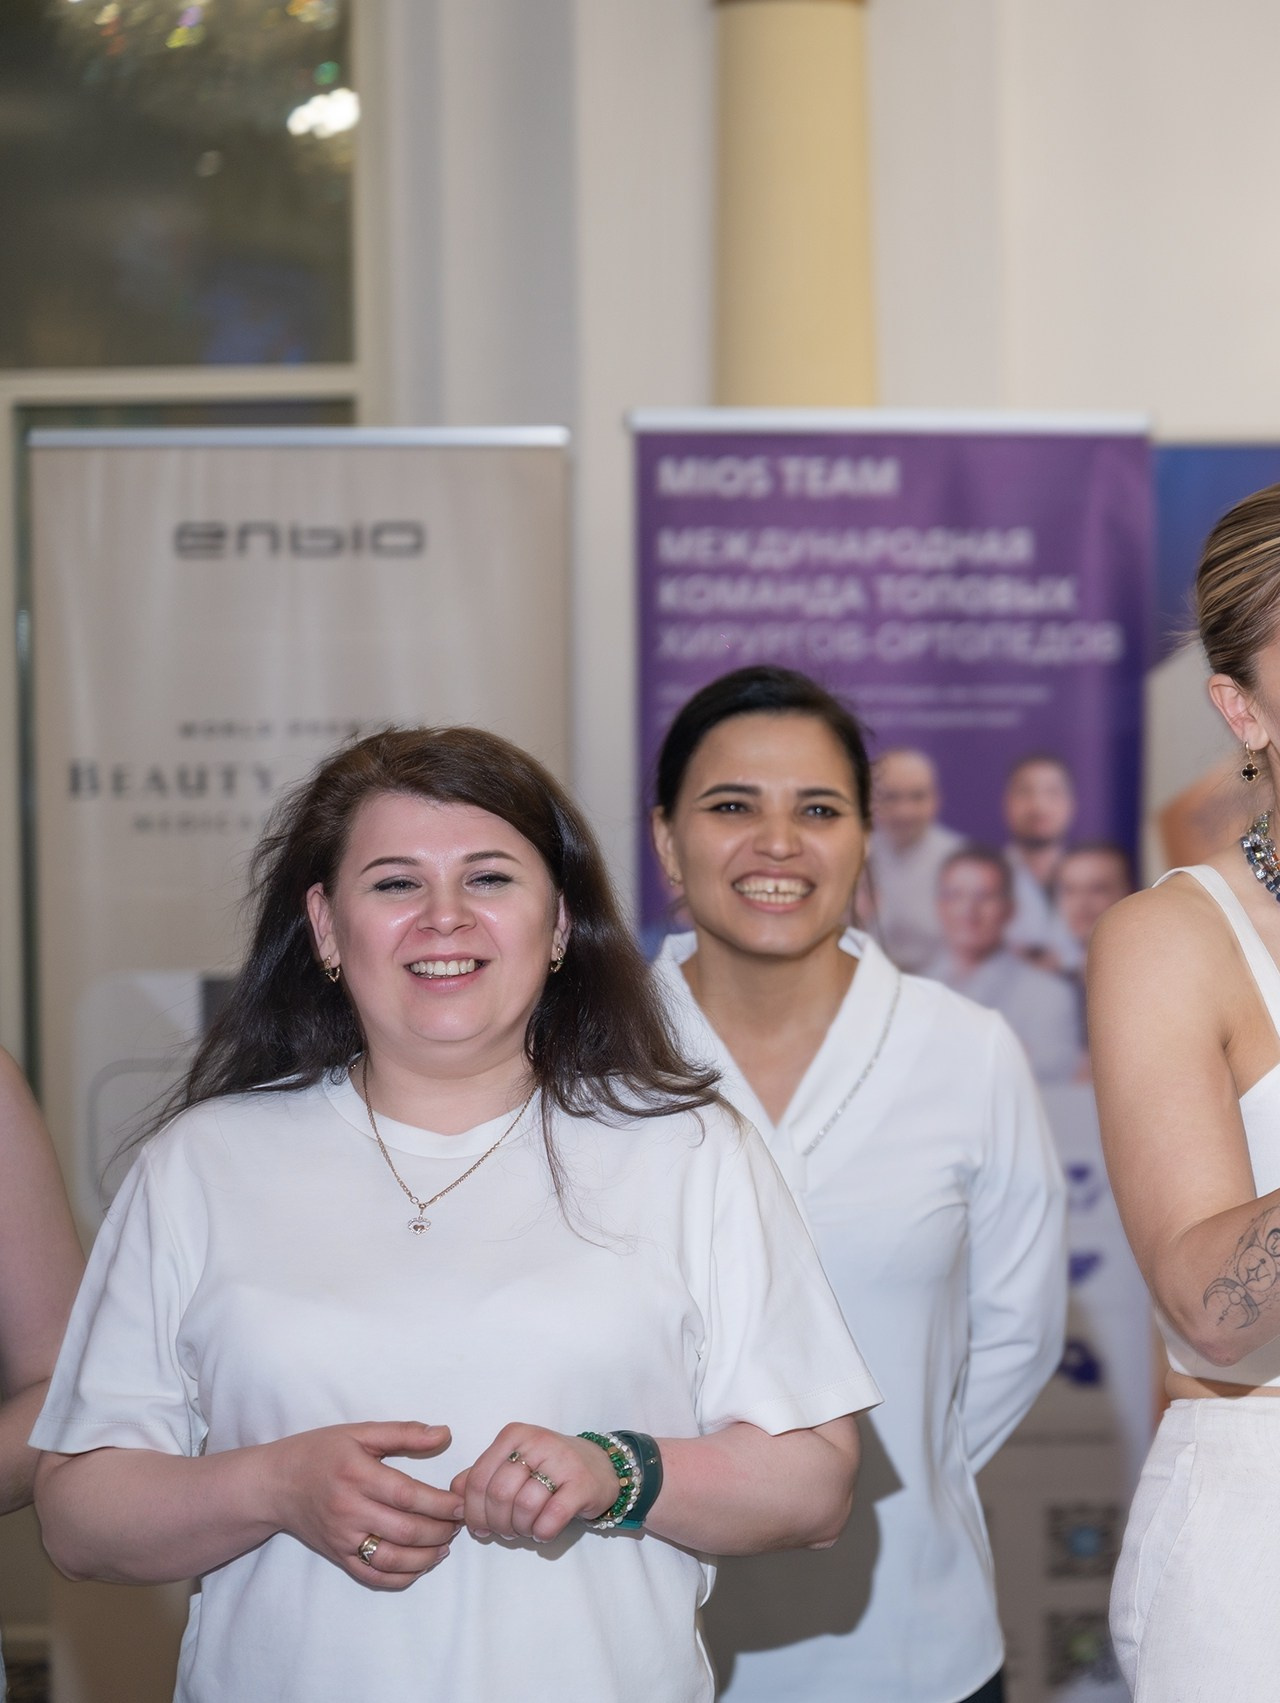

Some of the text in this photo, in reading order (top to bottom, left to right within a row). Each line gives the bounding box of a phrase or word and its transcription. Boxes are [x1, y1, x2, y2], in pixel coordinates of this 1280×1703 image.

[658, 457, 899, 496] MIOS TEAM
[173, 520, 426, 558] enbio
[657, 527, 1034, 568] МЕЖДУНАРОДНАЯ
[657, 575, 1078, 617] КОМАНДА ТОПОВЫХ
